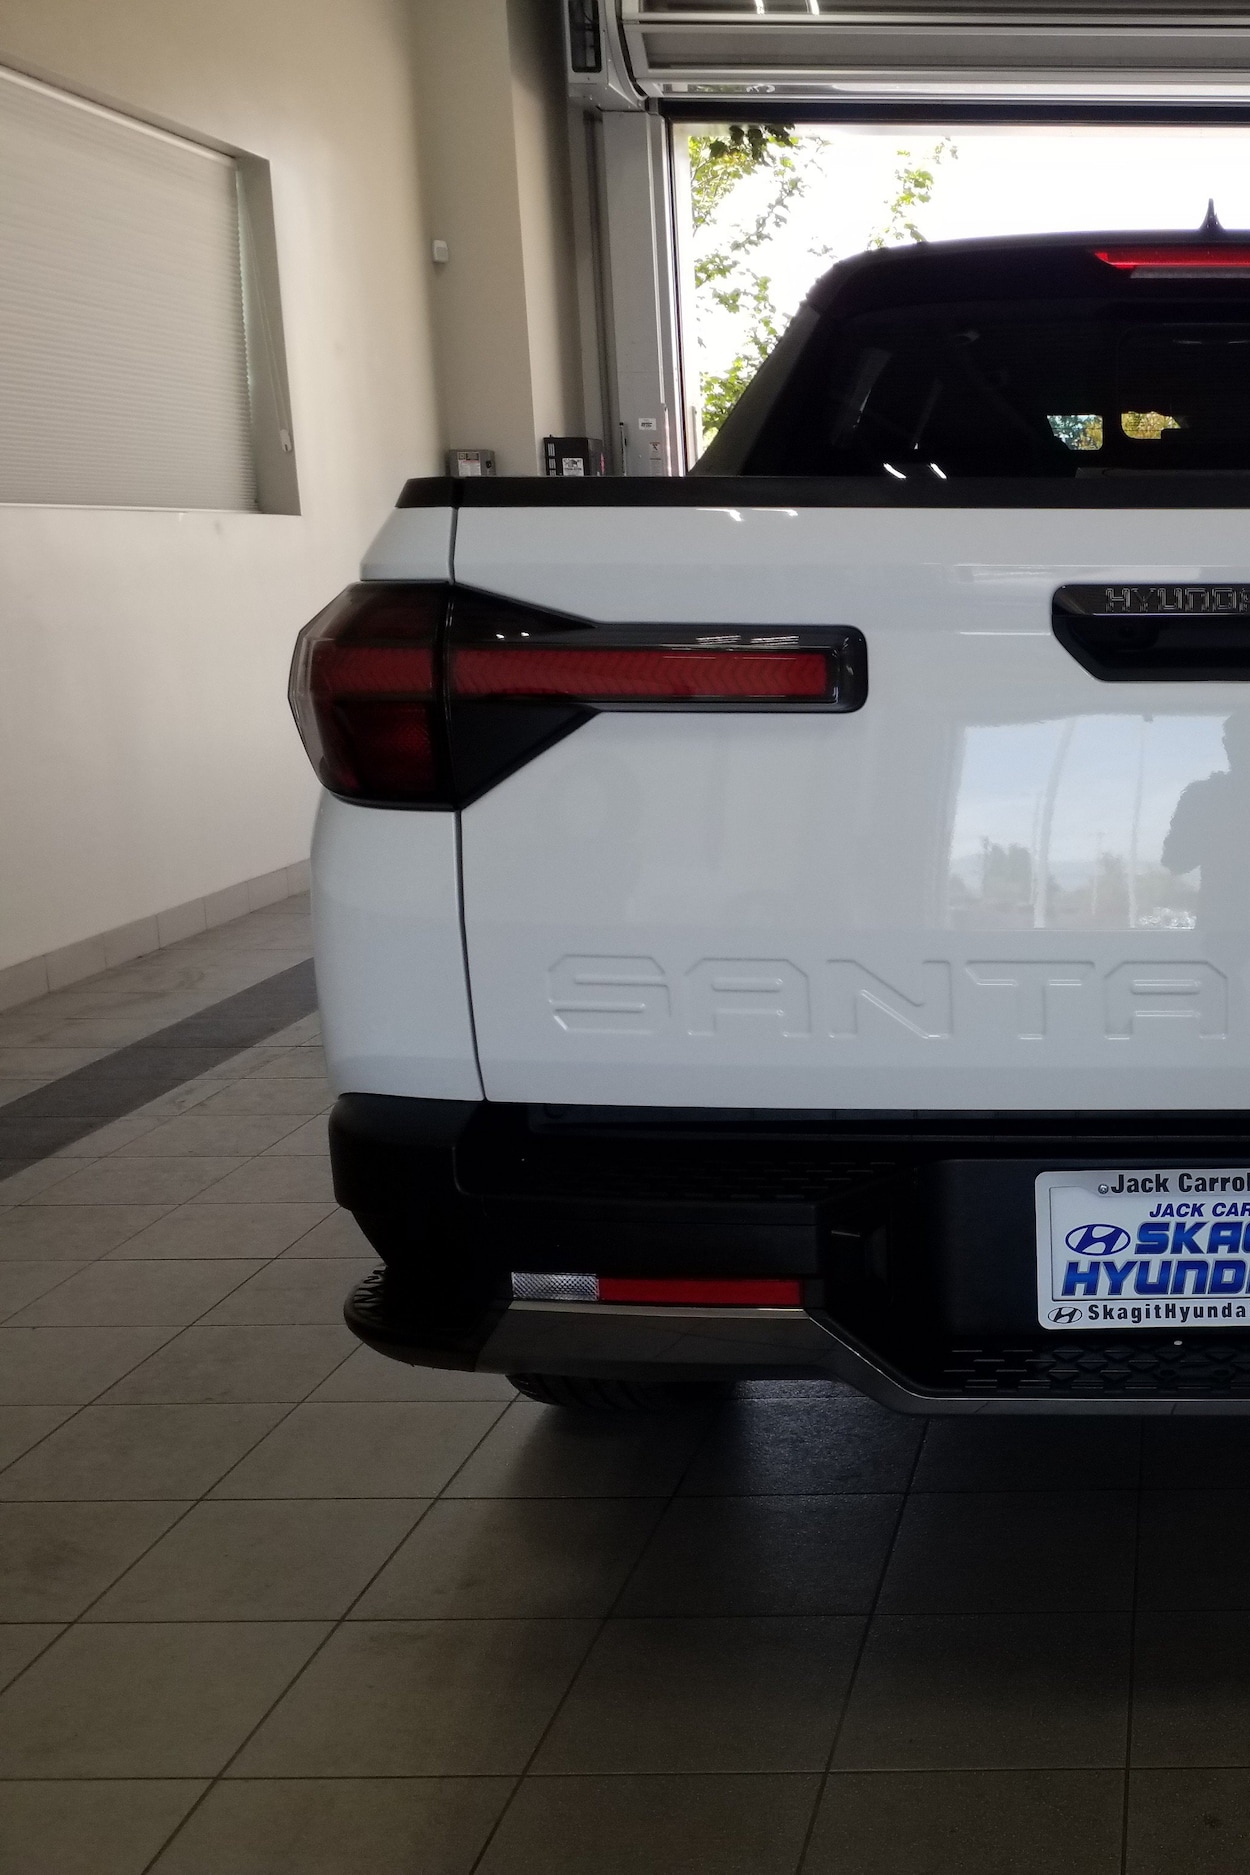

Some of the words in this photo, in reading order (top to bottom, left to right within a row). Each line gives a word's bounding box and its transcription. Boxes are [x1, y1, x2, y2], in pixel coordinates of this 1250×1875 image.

[548, 953, 1229, 1039] SANTA
[1111, 1174, 1169, 1194] Jack
[1149, 1203, 1206, 1217] JACK
